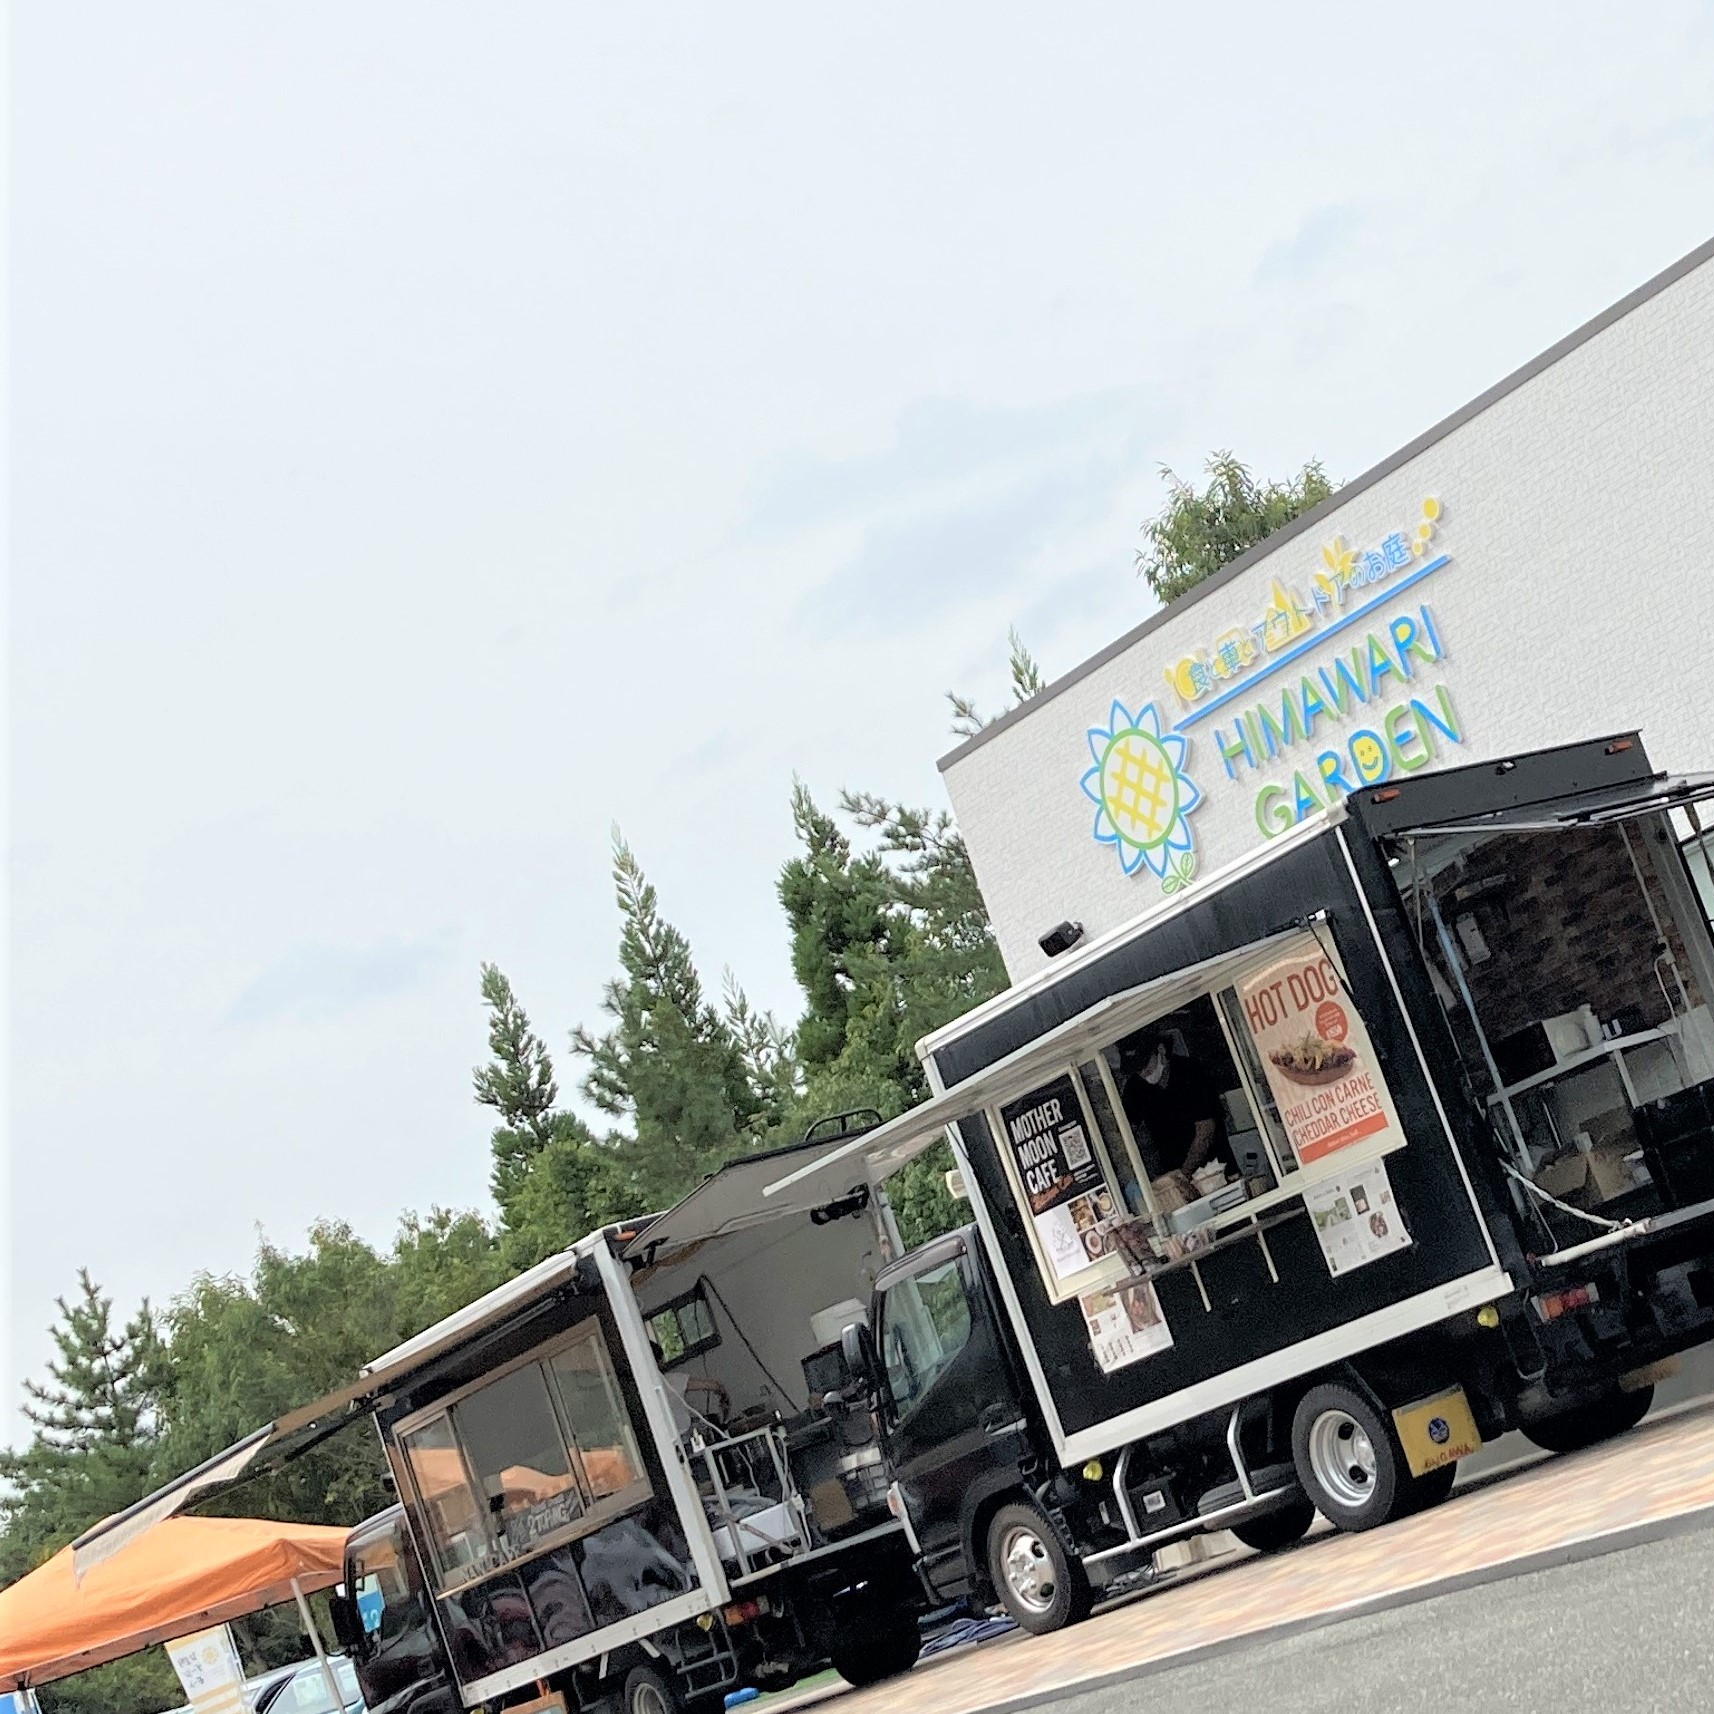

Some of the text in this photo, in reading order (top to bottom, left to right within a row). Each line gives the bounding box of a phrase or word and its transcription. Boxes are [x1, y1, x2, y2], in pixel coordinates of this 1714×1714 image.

[1214, 604, 1443, 780] HIMAWARI
[1254, 684, 1463, 839] GARDEN
[1244, 980, 1288, 1034] HOT
[1287, 958, 1339, 1012] DOG
[1010, 1098, 1064, 1145] MOTHER
[1284, 1072, 1375, 1128] CHILI CON CARNE
[1292, 1112, 1342, 1148] CHEDDAR
[1341, 1093, 1383, 1124] CHEESE
[1017, 1130, 1058, 1170] MOON
[1025, 1159, 1060, 1195] CAFE
